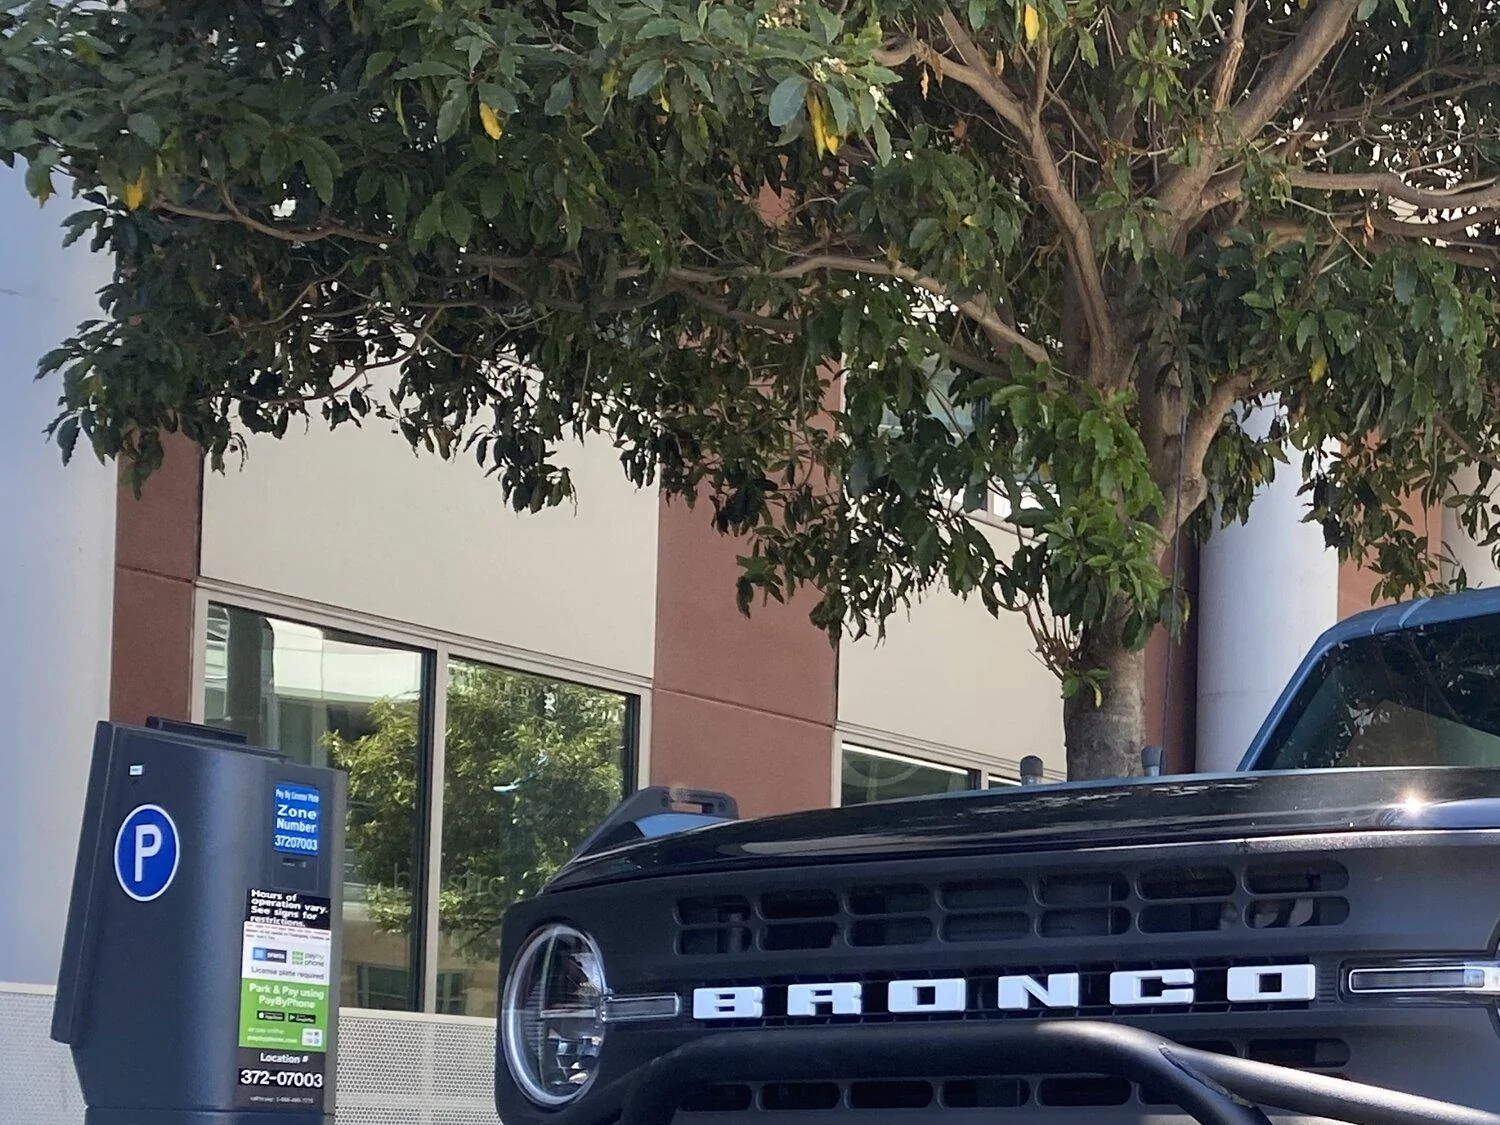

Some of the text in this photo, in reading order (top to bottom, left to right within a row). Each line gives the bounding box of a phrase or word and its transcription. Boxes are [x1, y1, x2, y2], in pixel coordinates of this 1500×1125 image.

[277, 804, 317, 820] Zone
[276, 817, 317, 833] Number
[274, 834, 318, 851] 37207003
[134, 824, 162, 882] P
[251, 889, 297, 902] Hours of
[250, 905, 318, 920] See signs for
[251, 898, 329, 914] operation vary.
[251, 966, 277, 975] License
[297, 971, 325, 979] required
[248, 982, 325, 1001] Park & Pay using
[692, 964, 1316, 1020] BRONCO
[258, 994, 316, 1009] PayByPhone
[260, 1052, 309, 1064] Location #
[240, 1069, 323, 1088] 372-07003
